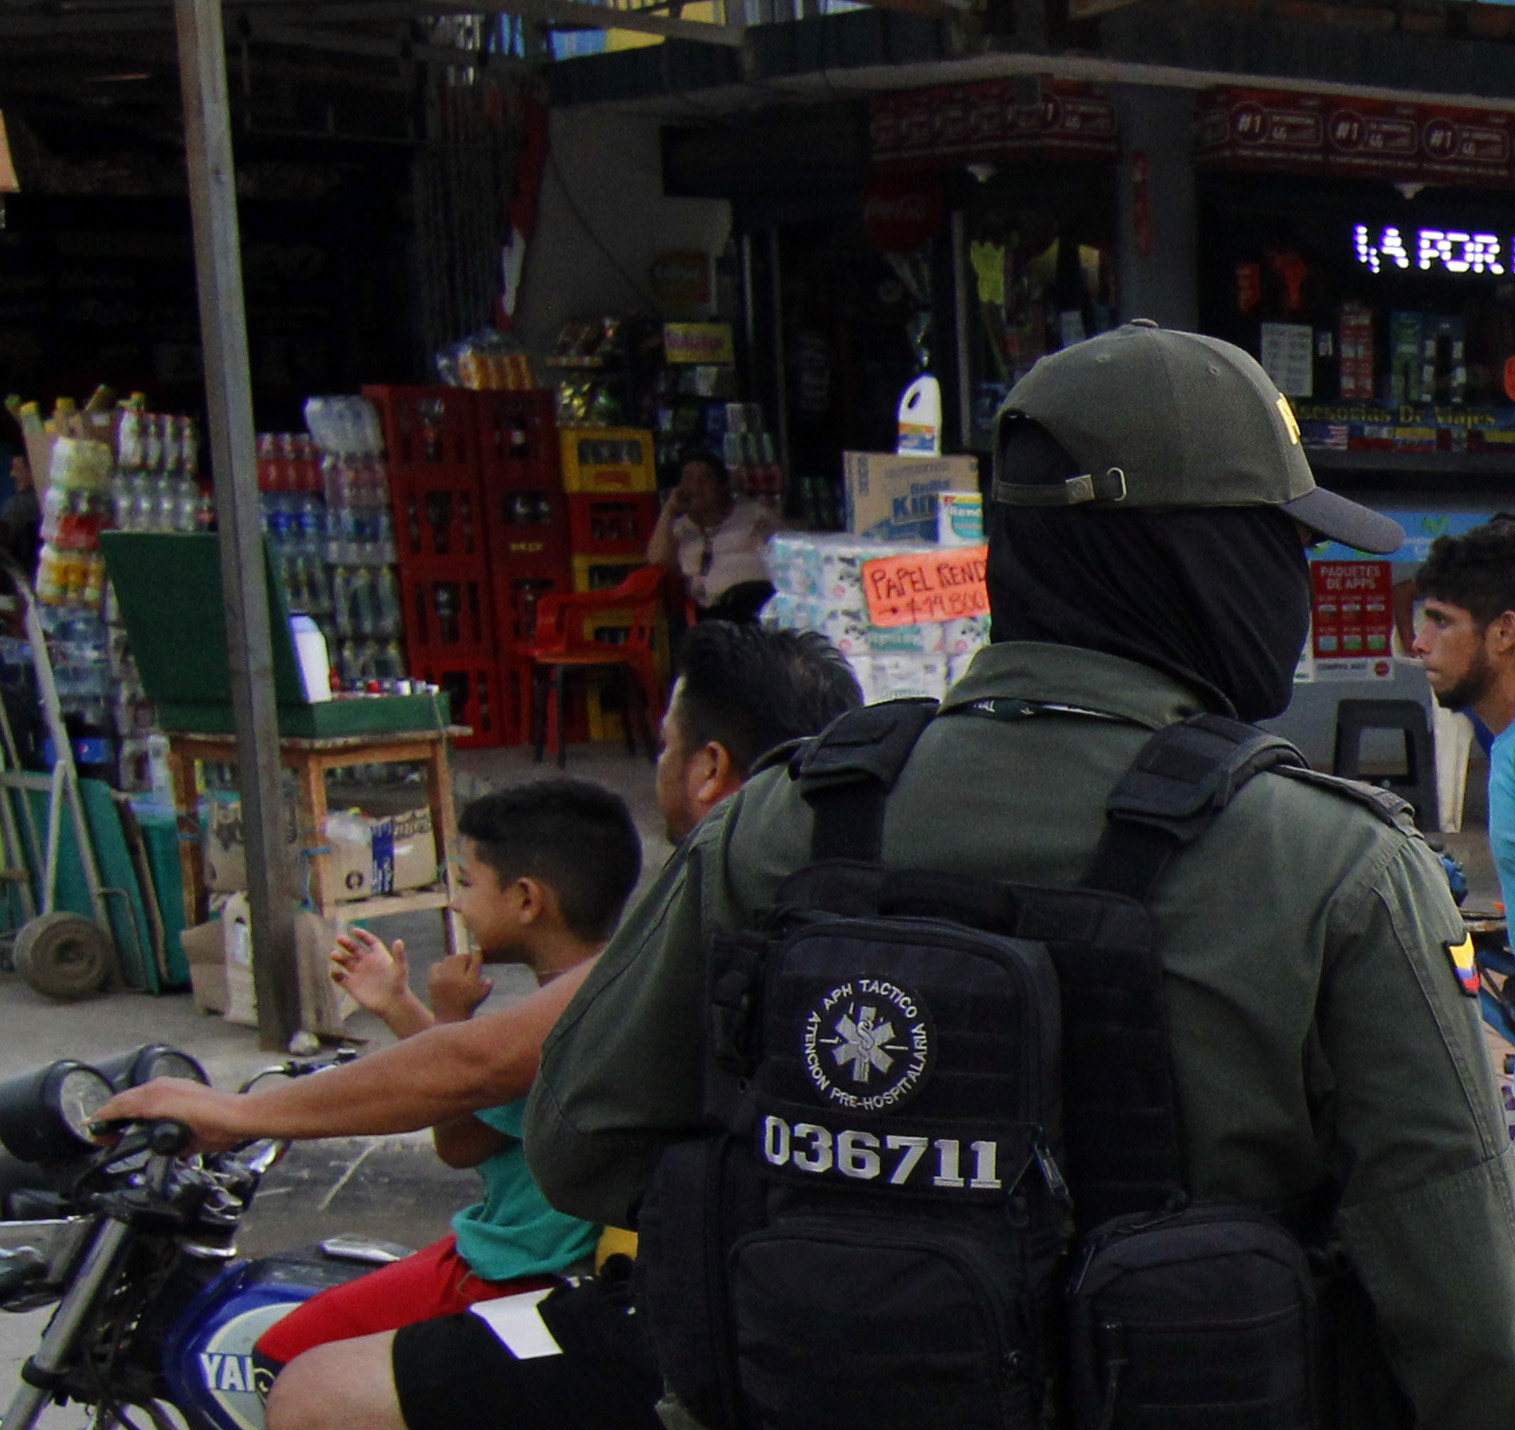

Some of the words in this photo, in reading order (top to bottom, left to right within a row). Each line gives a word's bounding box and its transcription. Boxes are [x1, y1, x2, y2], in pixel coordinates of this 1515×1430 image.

[1417, 228, 1504, 275] POR
[870, 562, 936, 601] PAPEL
[1319, 565, 1381, 579] PAQUETES
[1326, 577, 1344, 590] DE
[1345, 578, 1376, 590] APPS
[821, 982, 853, 1011] APH
[858, 978, 919, 1020] TACTICO
[804, 1010, 831, 1091] ATENCION
[829, 1022, 928, 1111] PRE-HOSPITALARIA
[763, 1114, 1002, 1190] 036711
